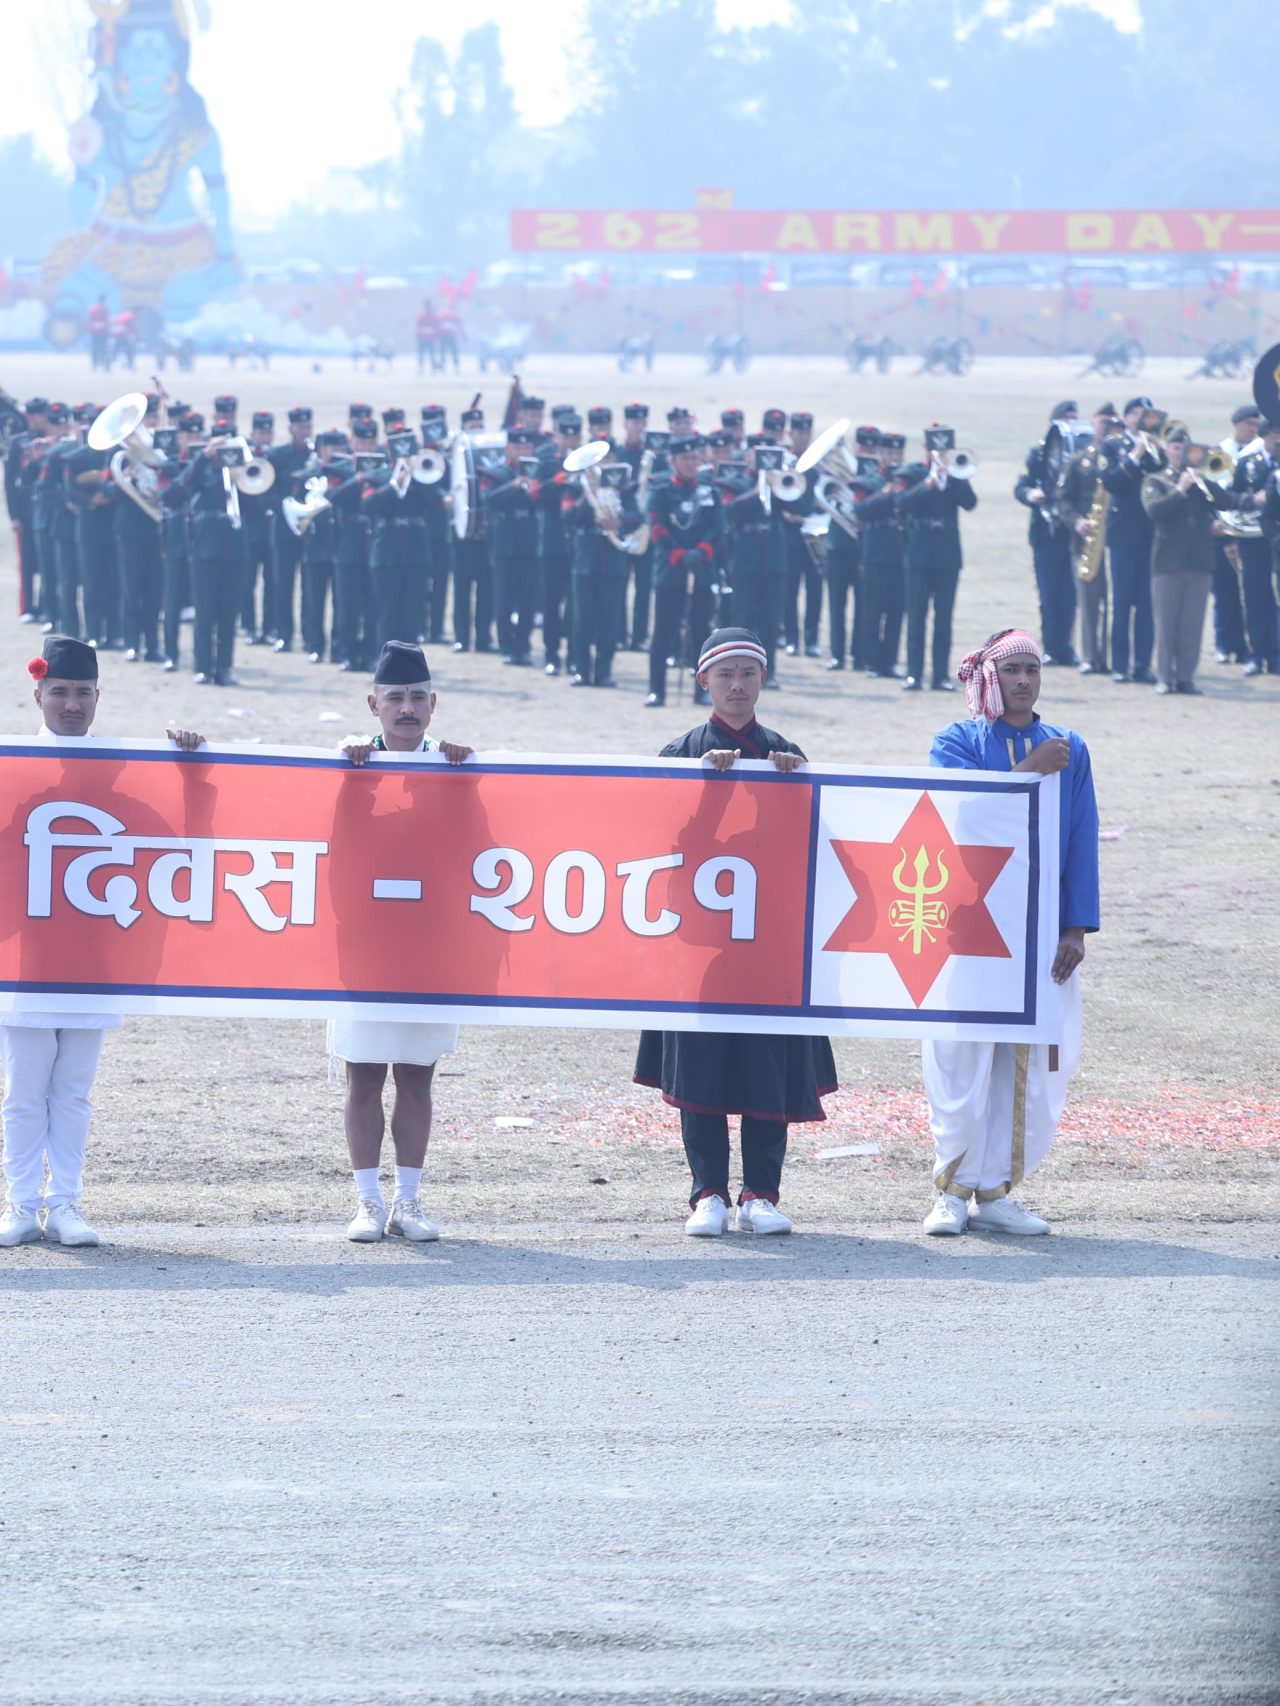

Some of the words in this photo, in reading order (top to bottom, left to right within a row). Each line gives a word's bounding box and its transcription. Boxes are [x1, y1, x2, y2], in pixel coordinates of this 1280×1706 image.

[534, 211, 702, 249] 262
[774, 212, 1011, 251] ARMY
[23, 801, 329, 932] दिवस
[470, 847, 758, 940] २०८१
